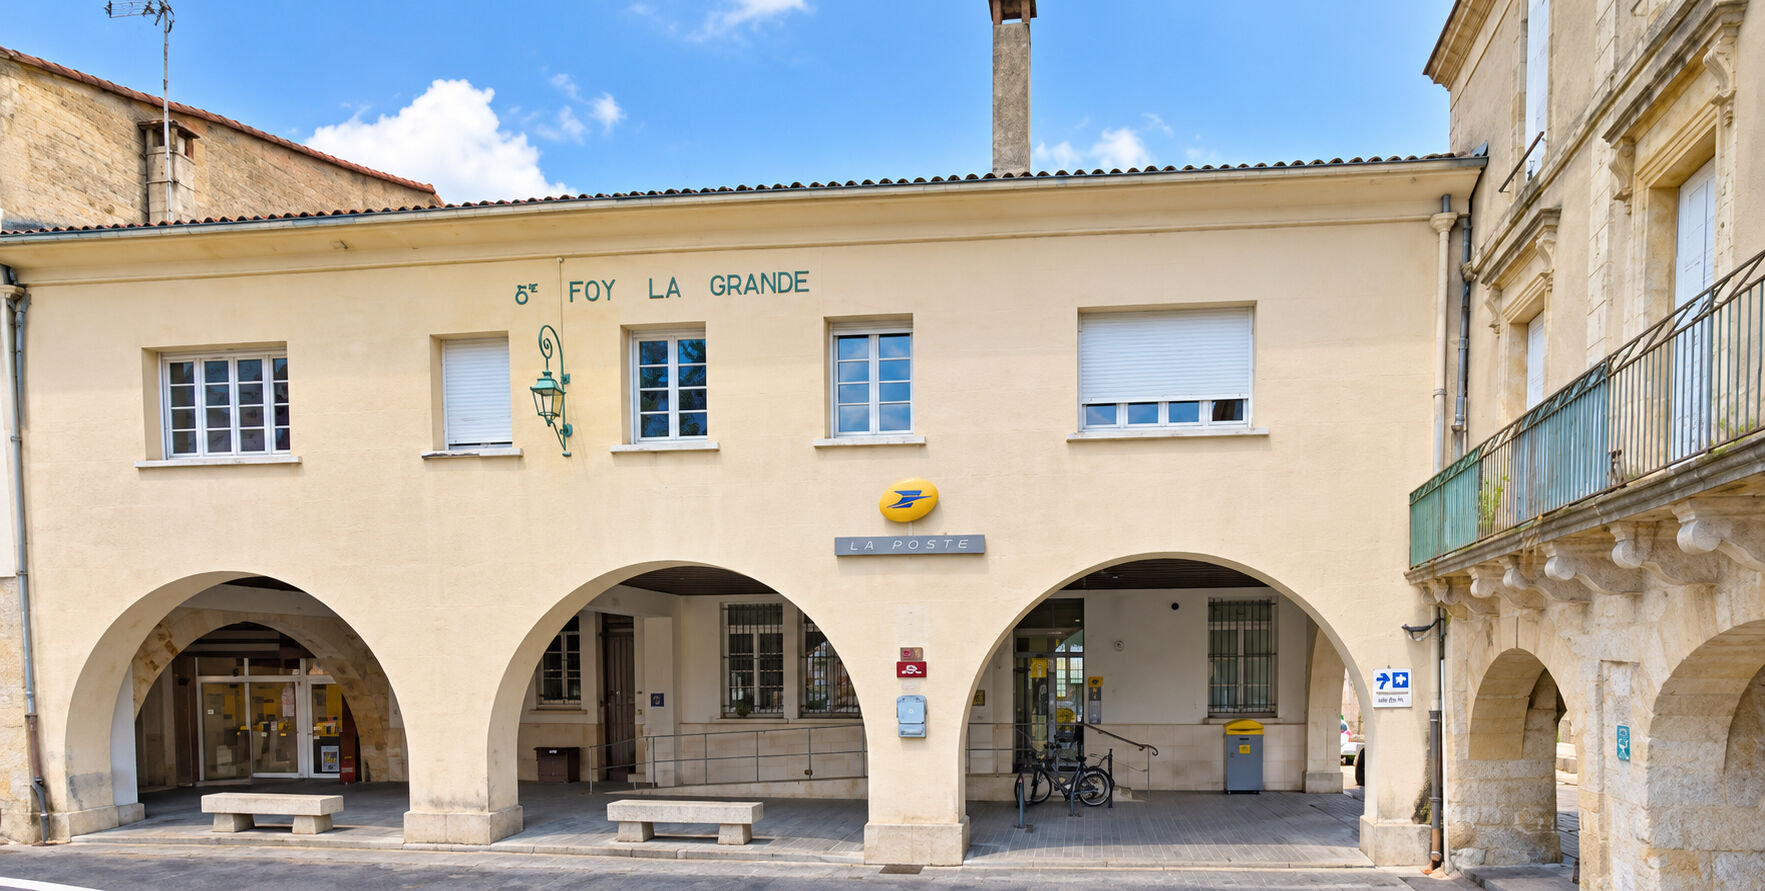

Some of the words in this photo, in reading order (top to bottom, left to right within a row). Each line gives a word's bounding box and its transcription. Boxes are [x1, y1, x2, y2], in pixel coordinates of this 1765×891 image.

[569, 279, 616, 302] FOY
[649, 276, 681, 299] LA
[710, 270, 809, 296] GRANDE
[850, 540, 874, 551] LA
[892, 539, 969, 550] POSTE
